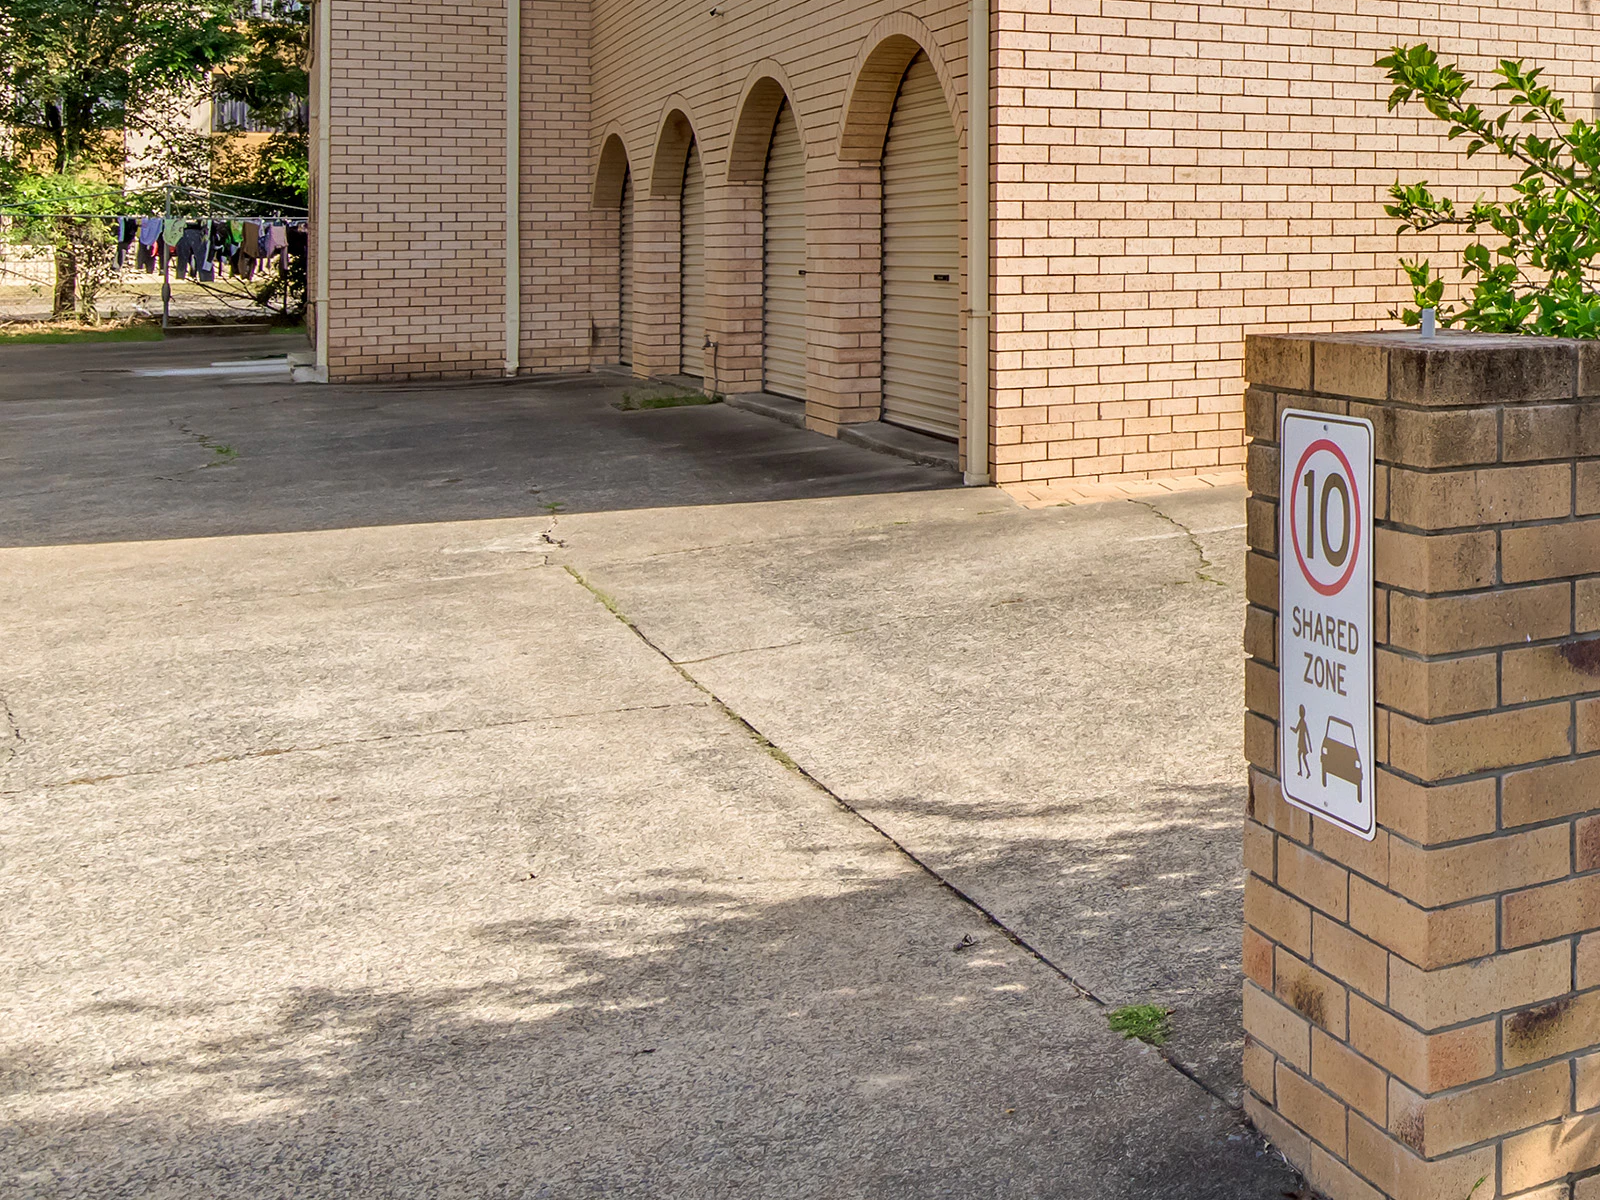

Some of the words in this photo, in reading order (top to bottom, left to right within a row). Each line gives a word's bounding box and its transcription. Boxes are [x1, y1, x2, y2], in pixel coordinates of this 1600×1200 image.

[1303, 469, 1350, 567] 10
[1292, 605, 1359, 655] SHARED
[1303, 652, 1347, 696] ZONE
